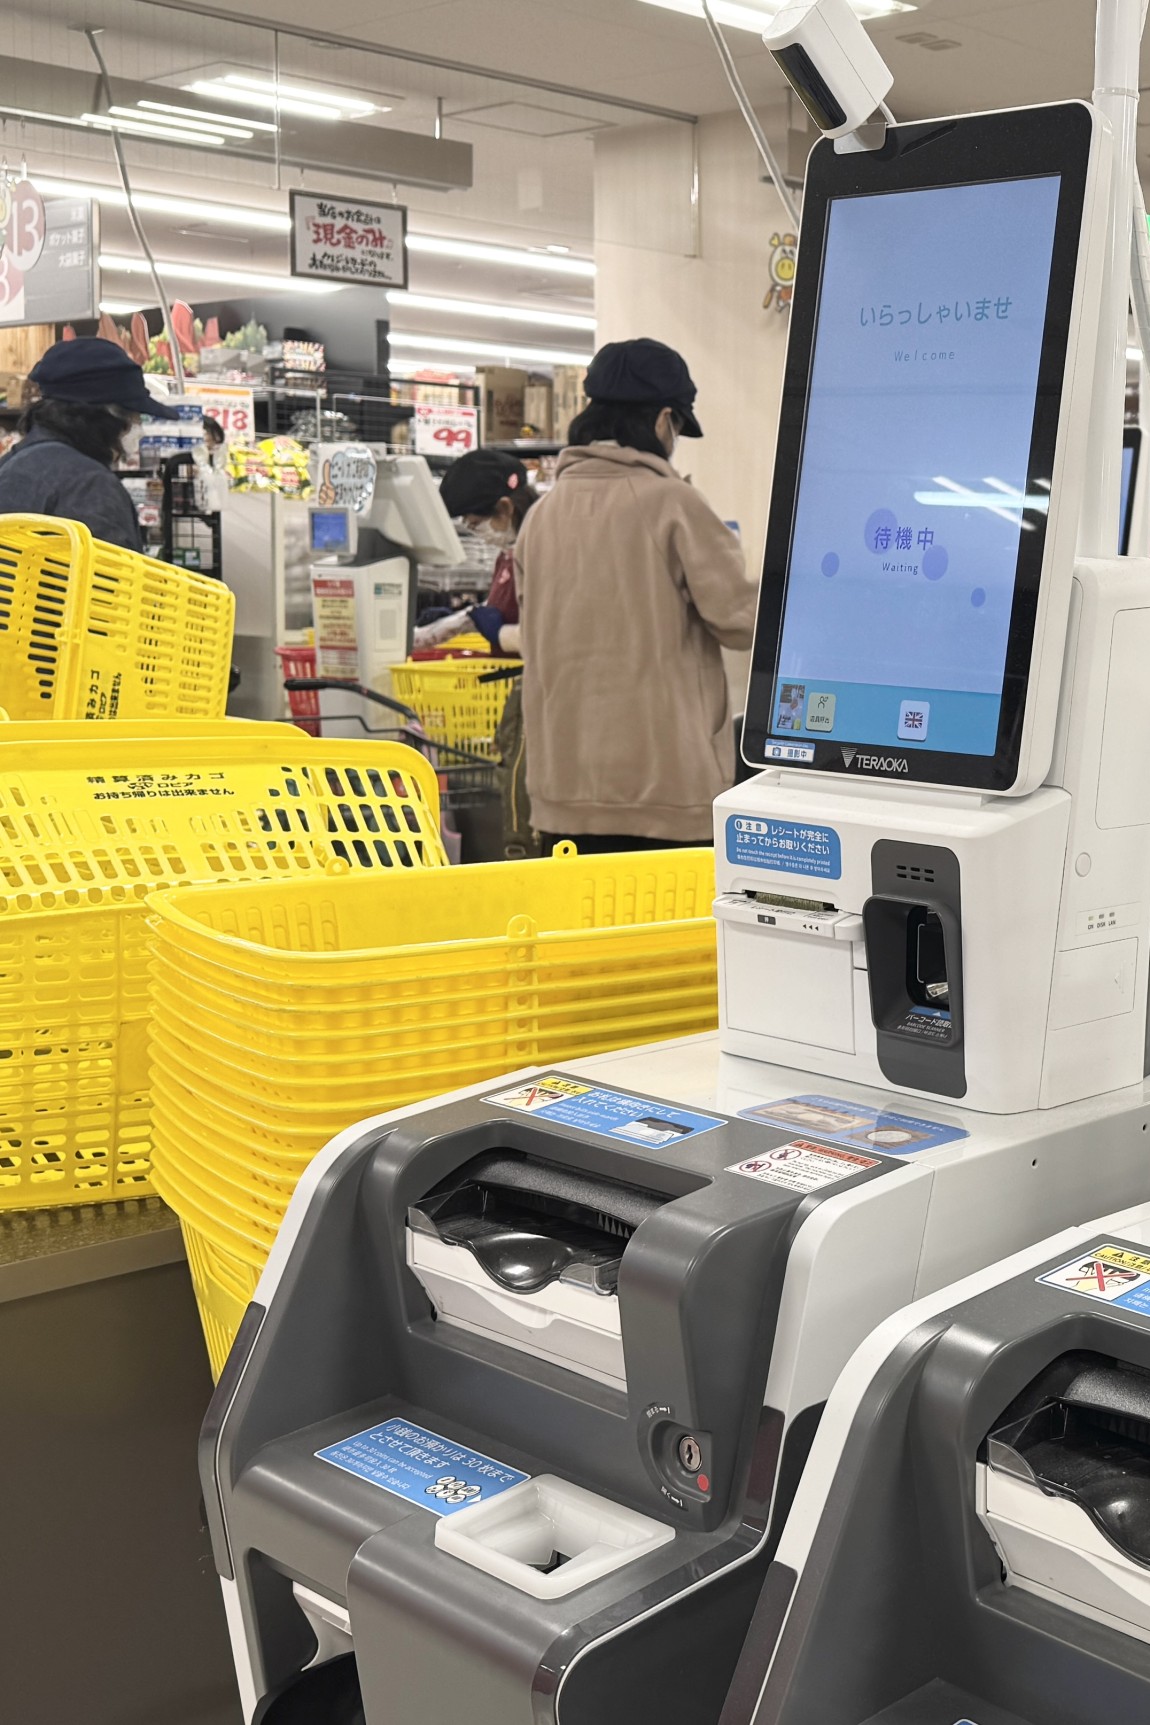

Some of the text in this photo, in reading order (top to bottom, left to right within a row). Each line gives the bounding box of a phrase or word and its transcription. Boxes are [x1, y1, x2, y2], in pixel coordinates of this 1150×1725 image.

[12, 199, 39, 257] 13
[859, 296, 1013, 328] いらっしゃいませ
[894, 350, 956, 363] Welcome
[433, 428, 472, 449] 99
[873, 526, 935, 551] 待機中
[882, 562, 919, 575] Waiting
[856, 755, 909, 773] TERAOKA
[93, 788, 235, 800] お持ち帰りは出来ません
[736, 831, 829, 856] 止まってからお取りください
[771, 824, 828, 843] レシートが完全に
[369, 1431, 450, 1467] とさせて頂きます
[385, 1424, 514, 1482] 小銭のお預かりは 30 枚まで
